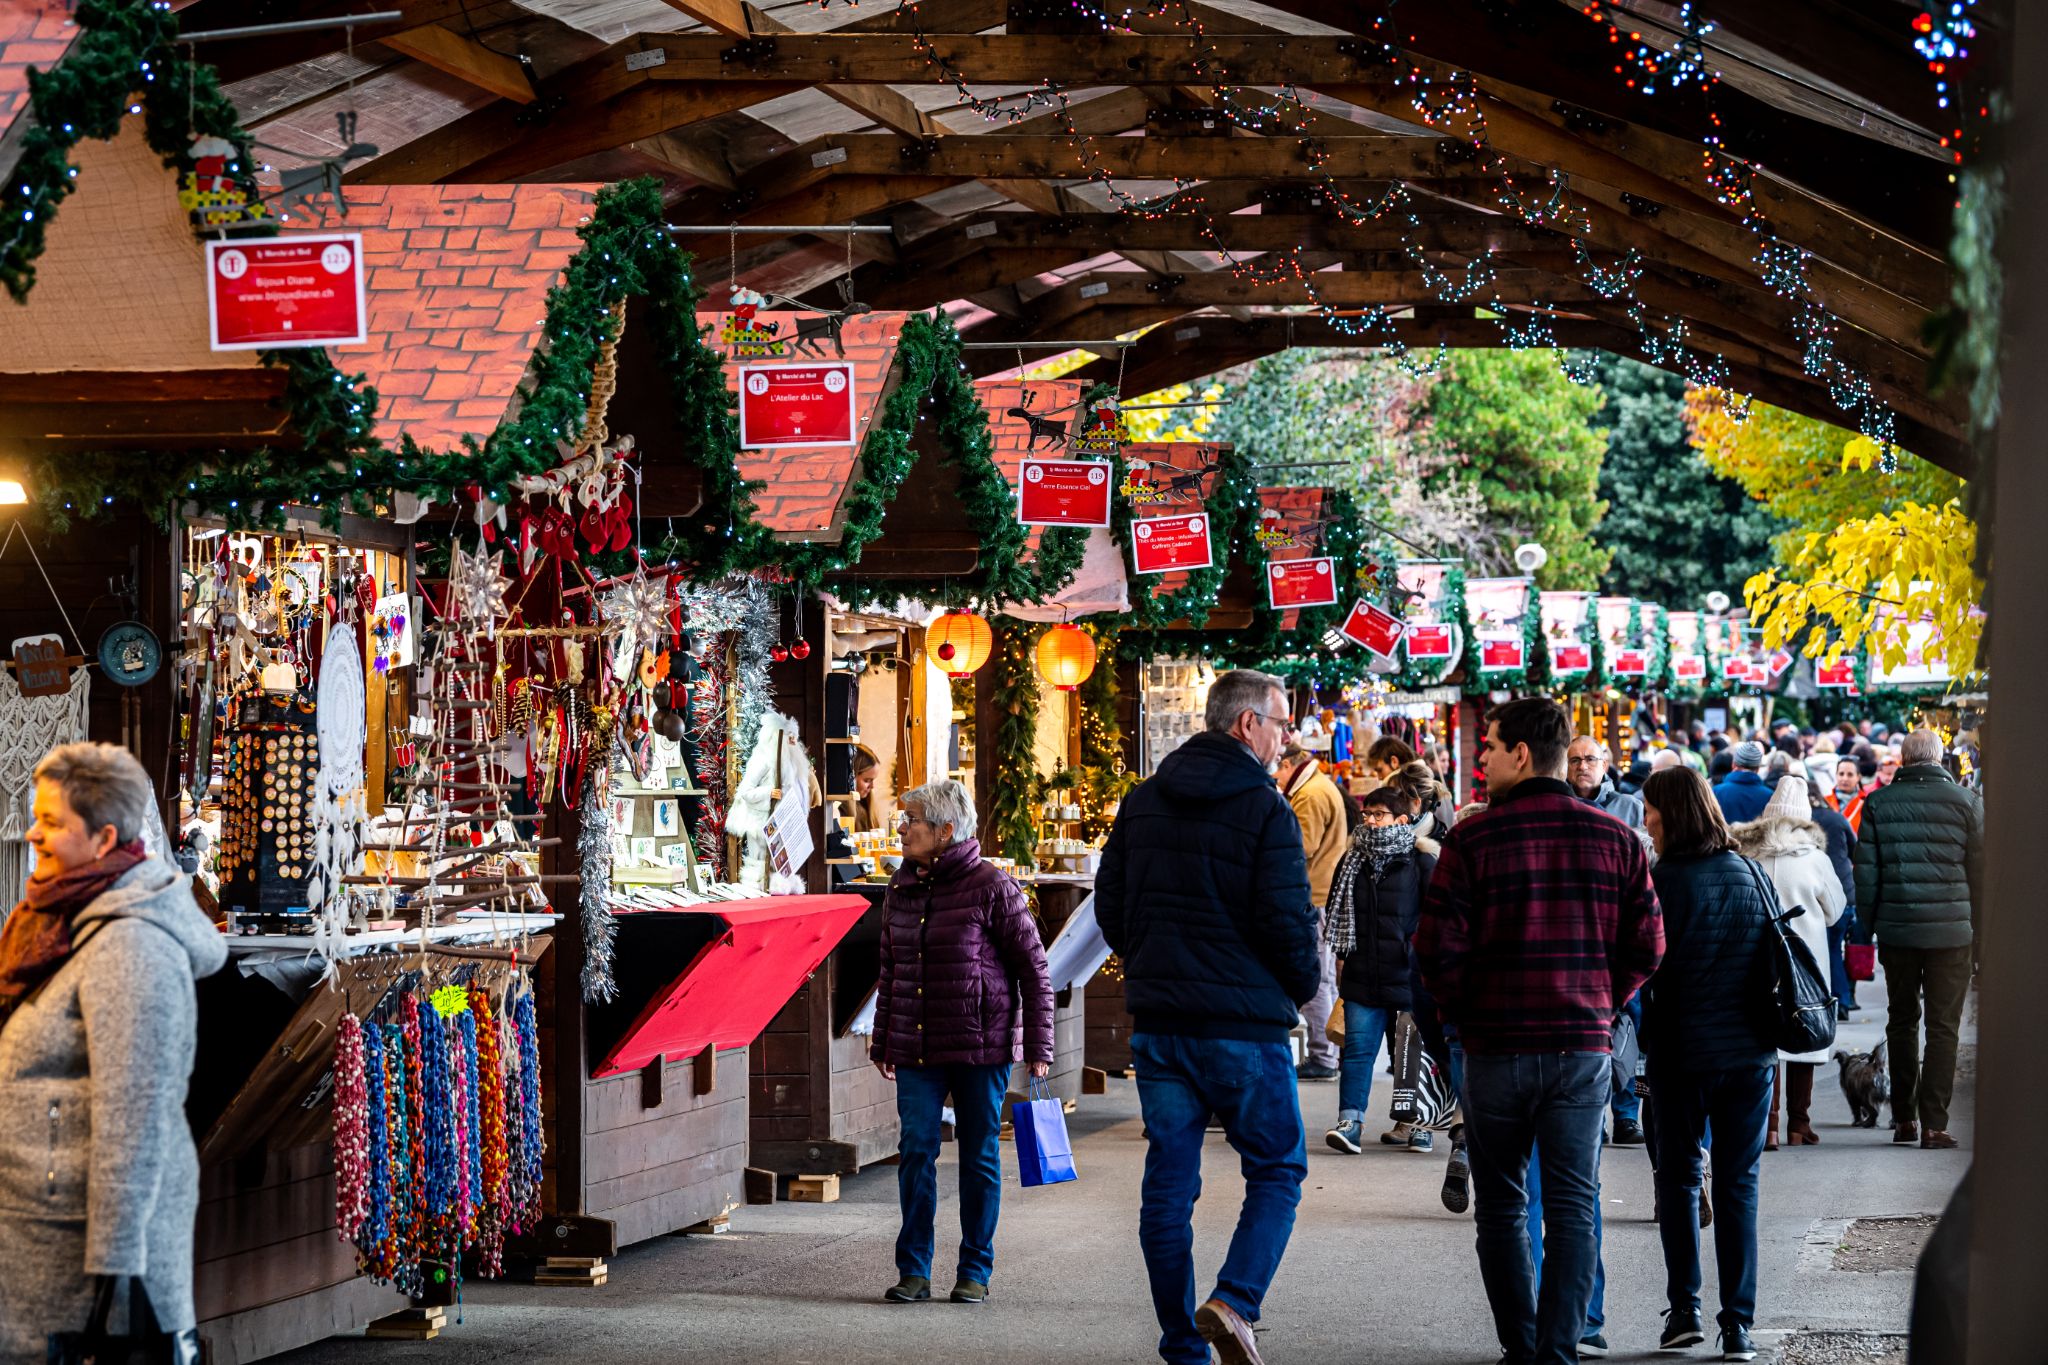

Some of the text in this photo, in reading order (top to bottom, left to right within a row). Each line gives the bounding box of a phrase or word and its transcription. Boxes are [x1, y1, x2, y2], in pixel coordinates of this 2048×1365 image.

[326, 252, 346, 264] 121
[255, 275, 315, 288] Bijoux Diane
[827, 377, 843, 386] 120
[770, 394, 799, 402] L'Atelier
[1091, 472, 1103, 480] 119
